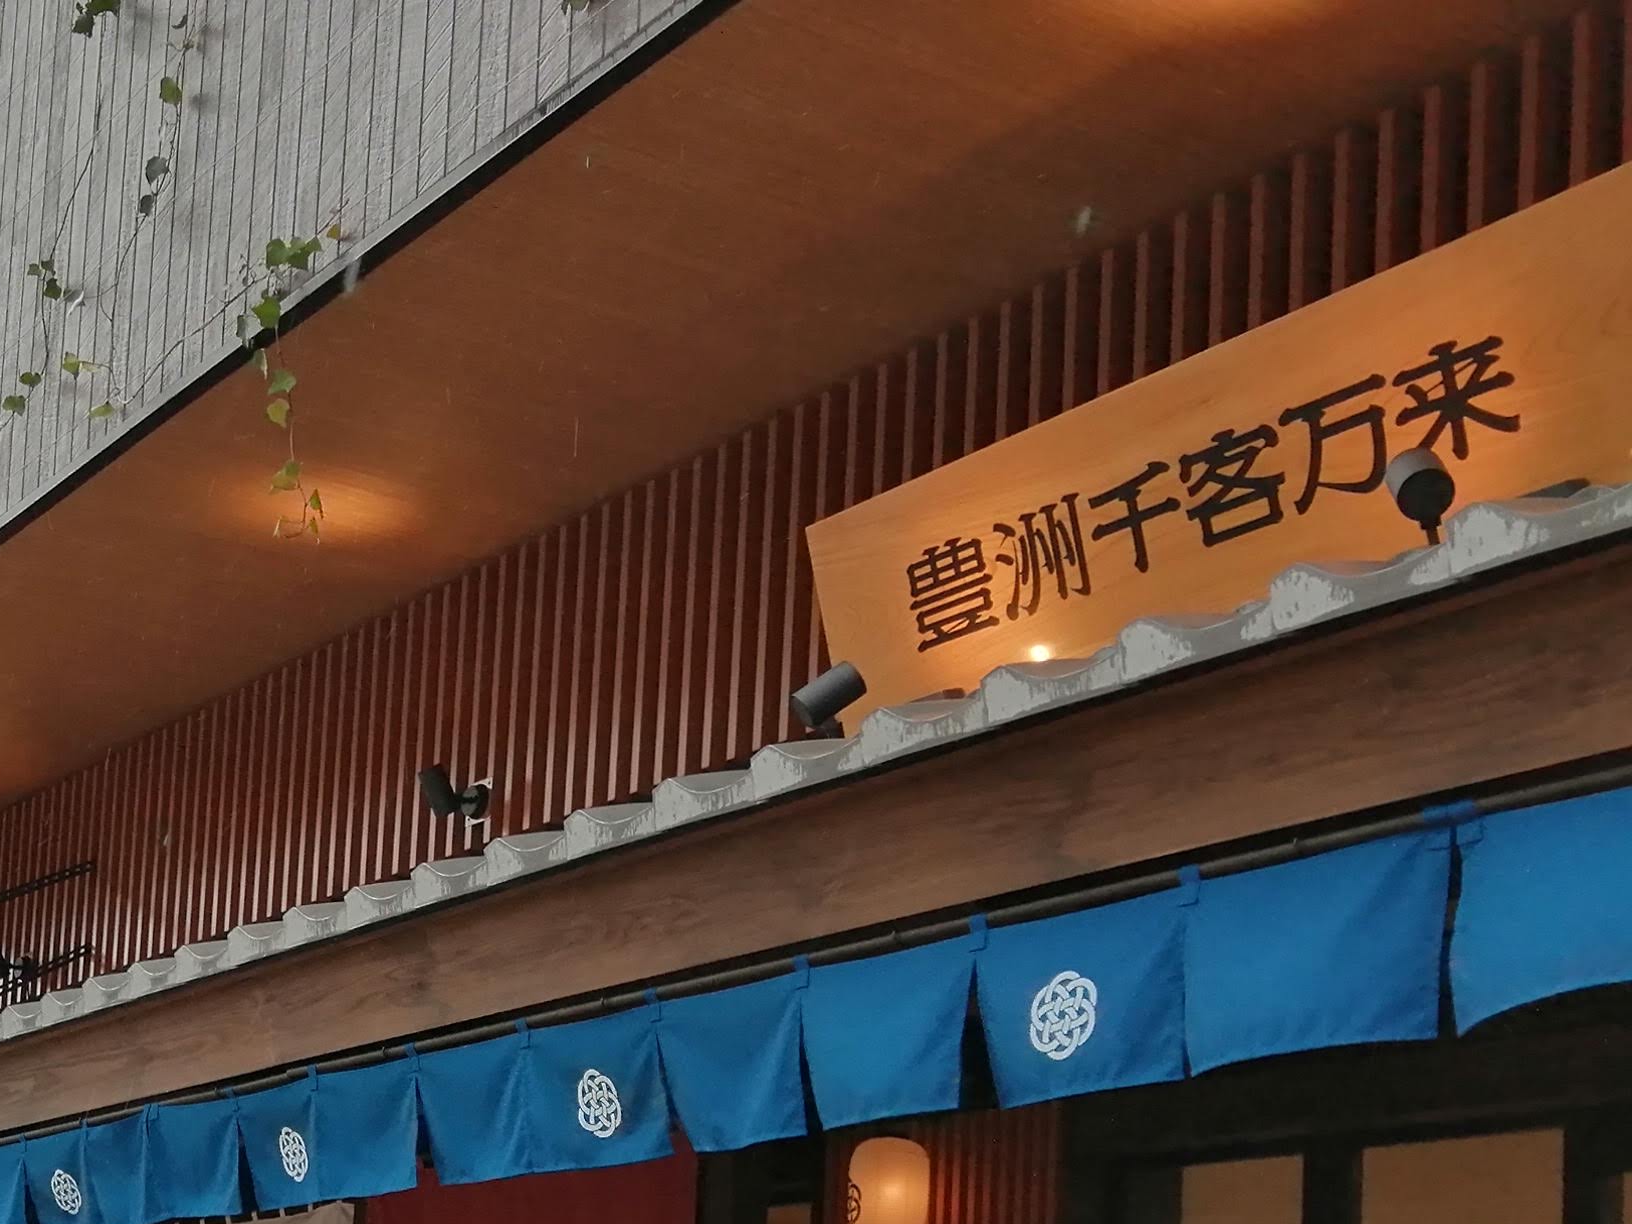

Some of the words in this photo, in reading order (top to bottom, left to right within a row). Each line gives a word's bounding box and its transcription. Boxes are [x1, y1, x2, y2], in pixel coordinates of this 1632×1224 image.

[907, 335, 1521, 652] 豊洲千客万来
